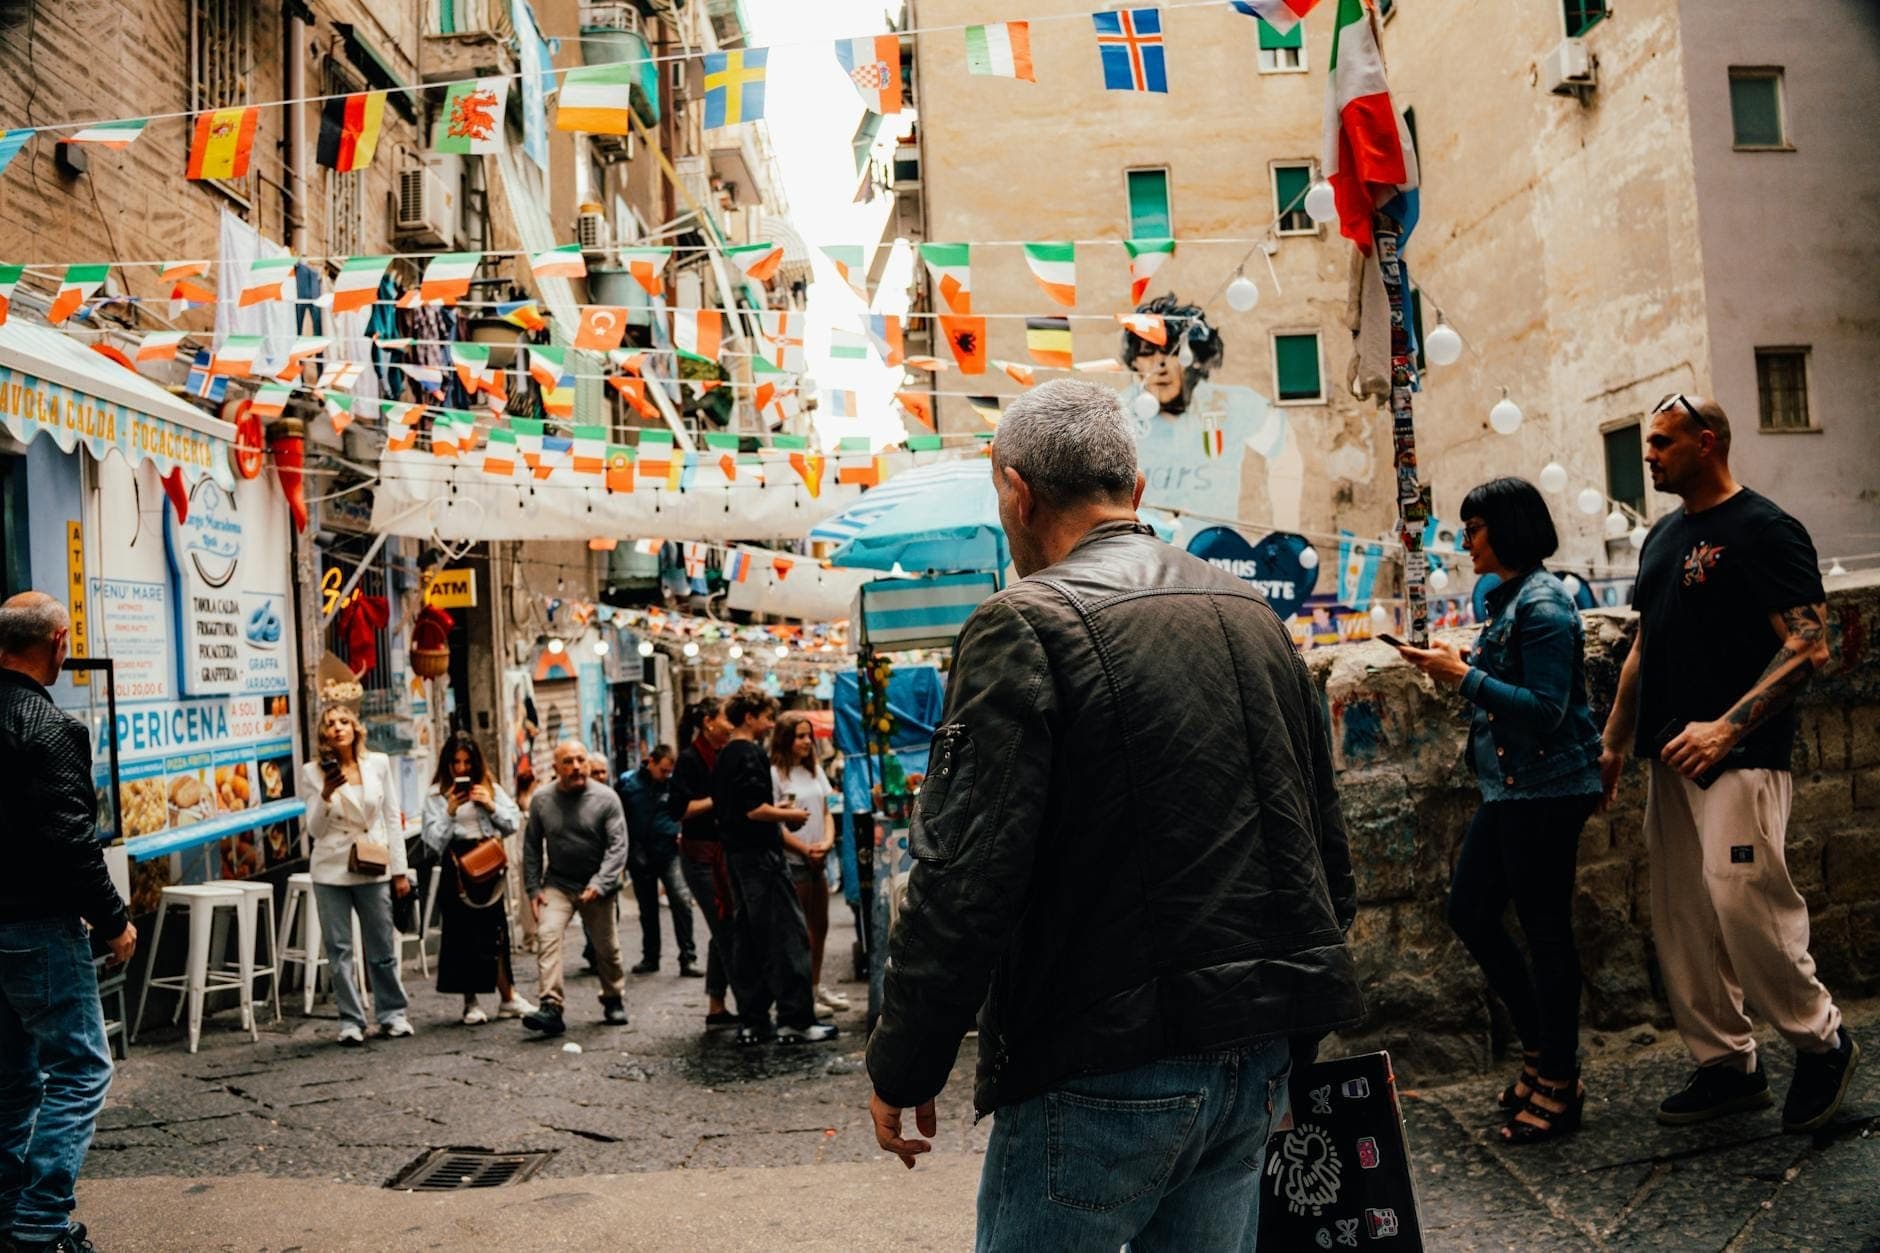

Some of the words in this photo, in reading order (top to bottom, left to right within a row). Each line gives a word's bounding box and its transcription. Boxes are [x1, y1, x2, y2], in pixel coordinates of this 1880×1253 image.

[66, 399, 115, 441] CALDA
[132, 419, 212, 468] FOCACCERIA
[73, 526, 81, 586] ATM
[133, 586, 164, 602] MARE
[431, 581, 468, 596] ATM
[249, 657, 279, 671] GRAFFA
[231, 703, 237, 716] A
[239, 702, 256, 716] SOLI
[97, 704, 228, 755] APERICENA
